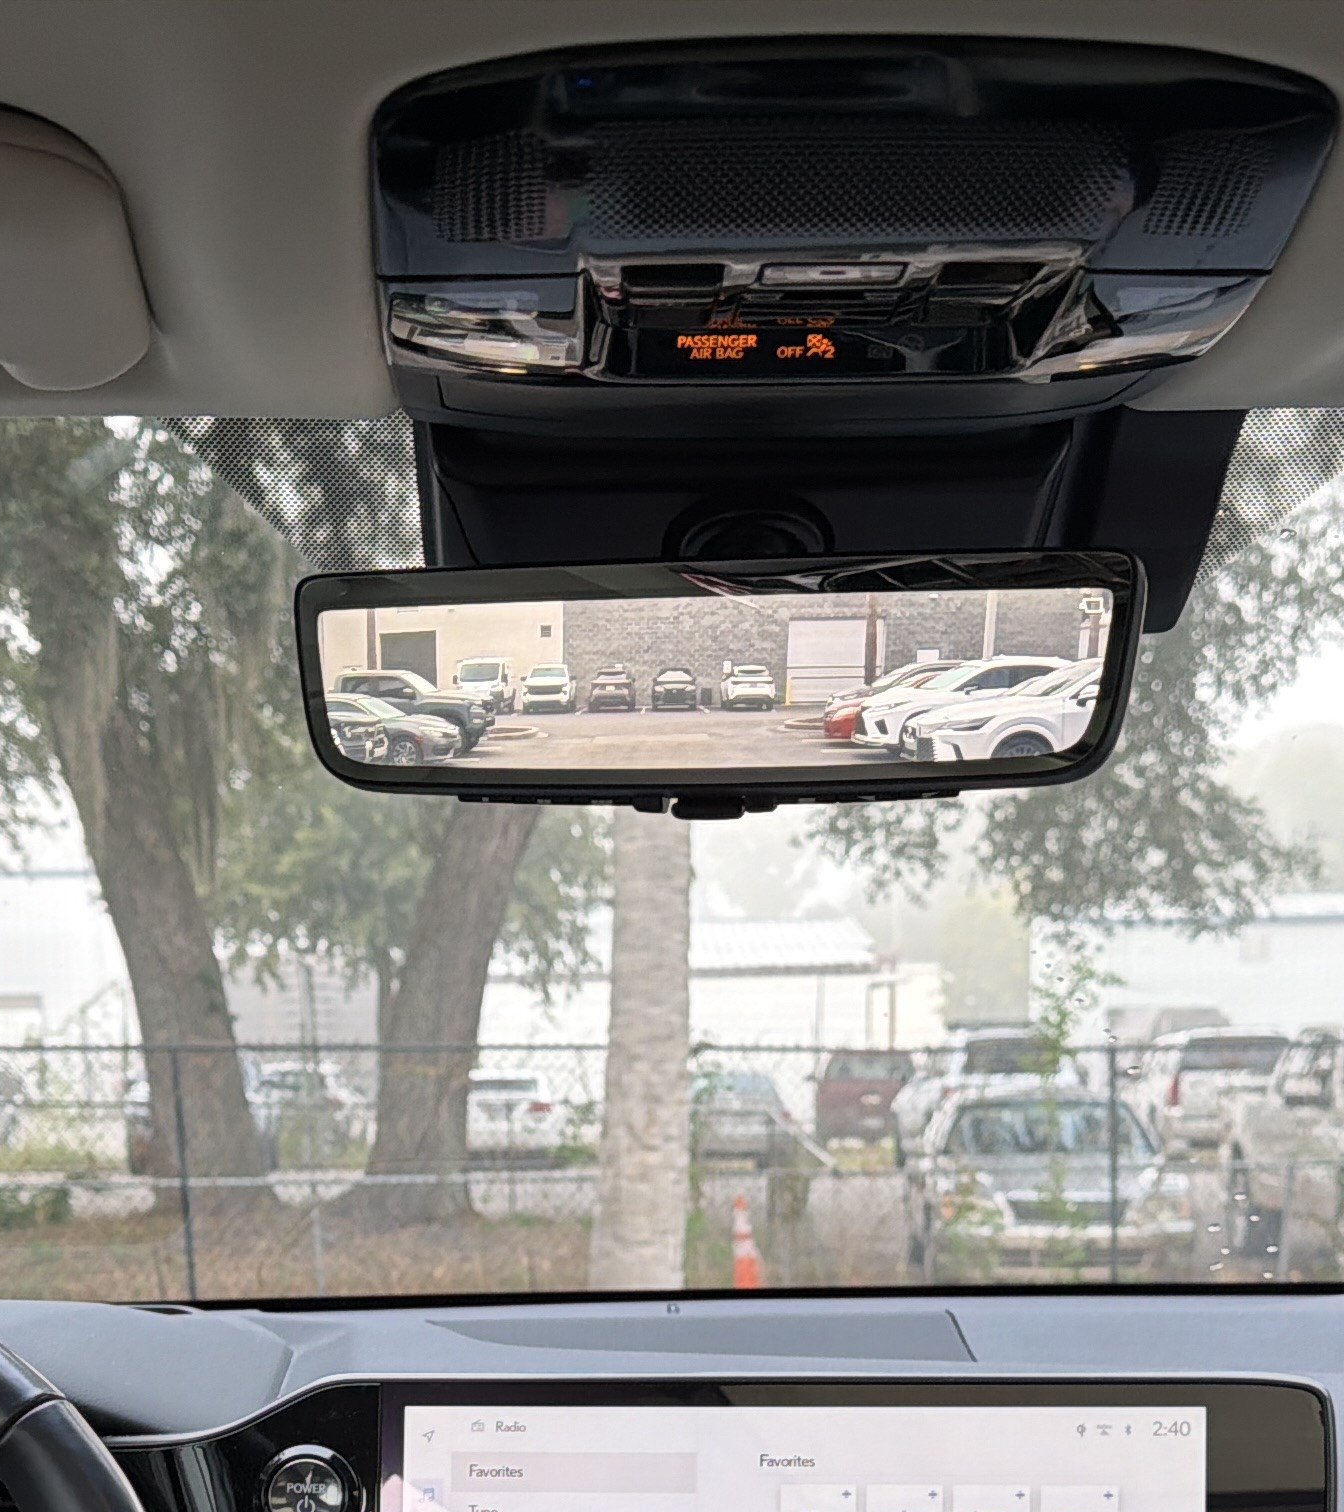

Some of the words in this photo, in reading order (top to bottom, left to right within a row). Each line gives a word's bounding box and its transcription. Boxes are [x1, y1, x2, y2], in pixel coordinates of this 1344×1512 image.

[677, 335, 757, 348] PASSENGER
[690, 348, 711, 359] AIR
[715, 348, 744, 359] BAG
[776, 347, 805, 359] OFF
[495, 1420, 527, 1433] Radio
[1153, 1421, 1192, 1437] 2:40
[759, 1454, 816, 1467] Favorites
[468, 1464, 524, 1478] Favorites
[286, 1482, 327, 1494] POWER
